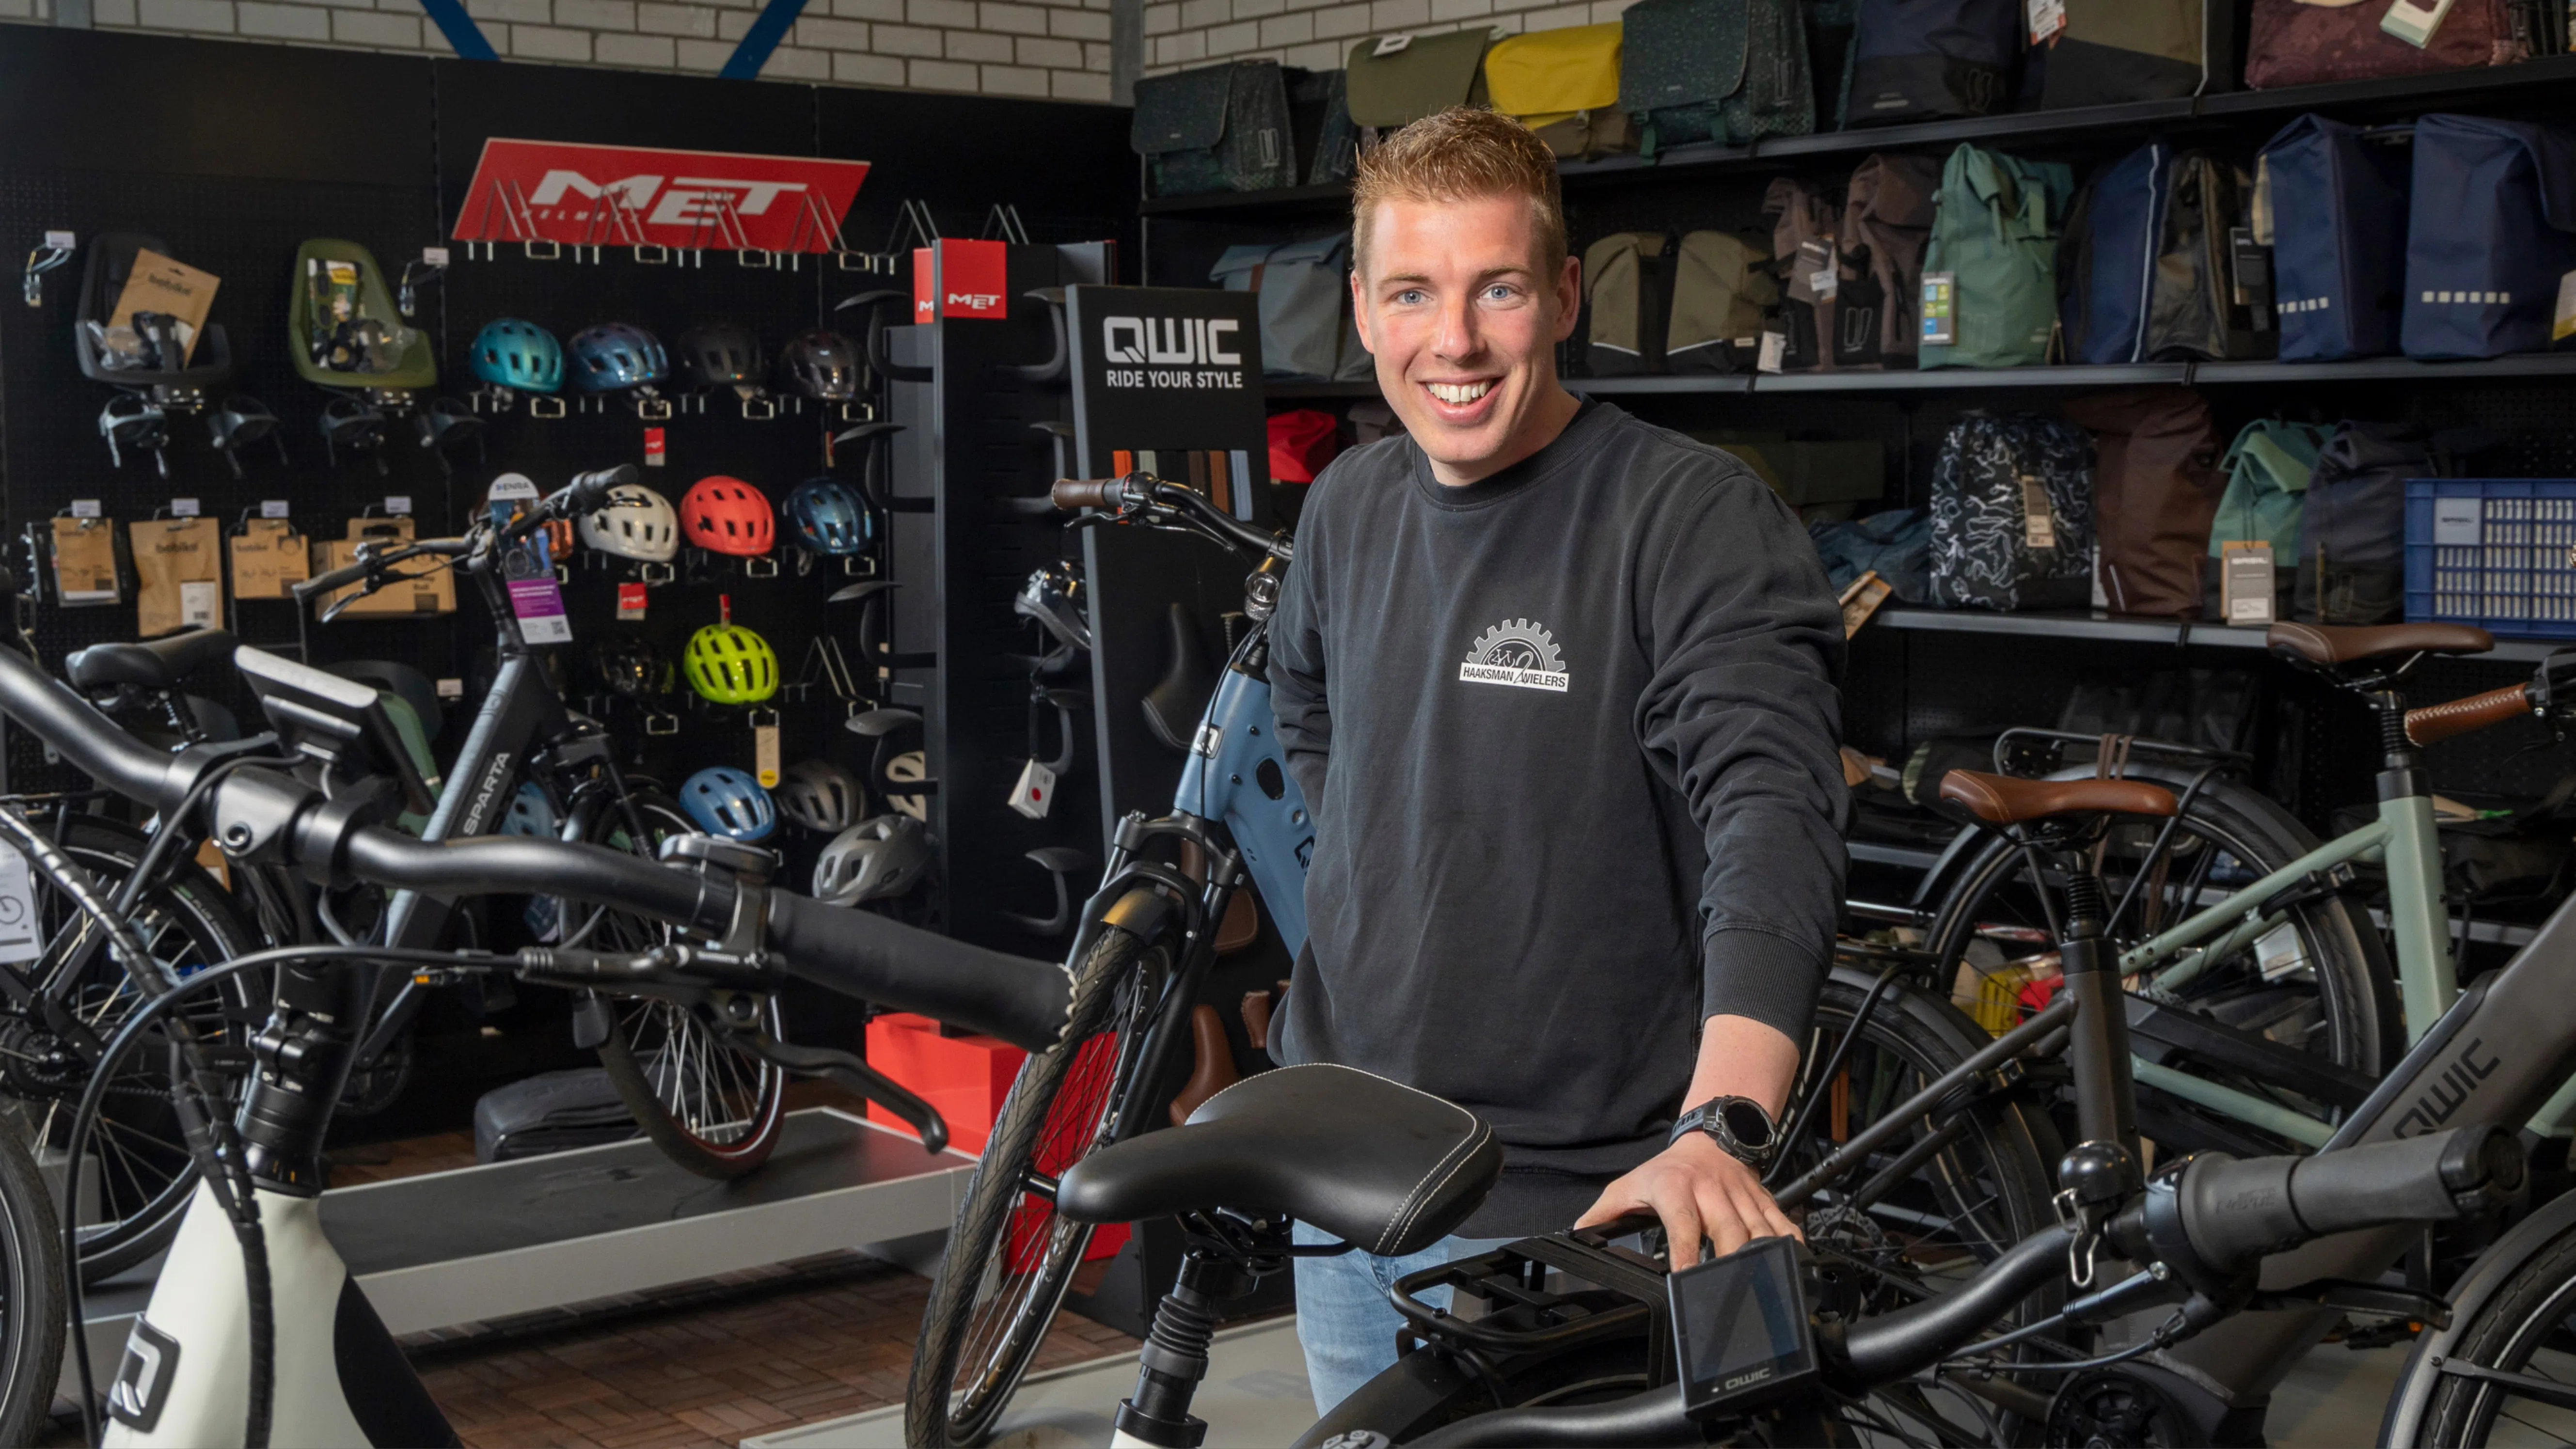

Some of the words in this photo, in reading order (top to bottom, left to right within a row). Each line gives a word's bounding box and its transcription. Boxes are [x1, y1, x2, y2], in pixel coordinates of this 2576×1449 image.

[529, 170, 808, 226] MET
[948, 293, 1001, 310] MET
[1103, 316, 1241, 364] QWIC
[1106, 370, 1145, 388] RIDE
[1148, 370, 1193, 388] YOUR
[1196, 371, 1243, 389] STYLE
[1463, 666, 1514, 682] HAAKSMAN
[463, 752, 510, 835] SPARTA
[2393, 1037, 2501, 1139] QWIC
[1724, 1367, 1771, 1391] QWIC
